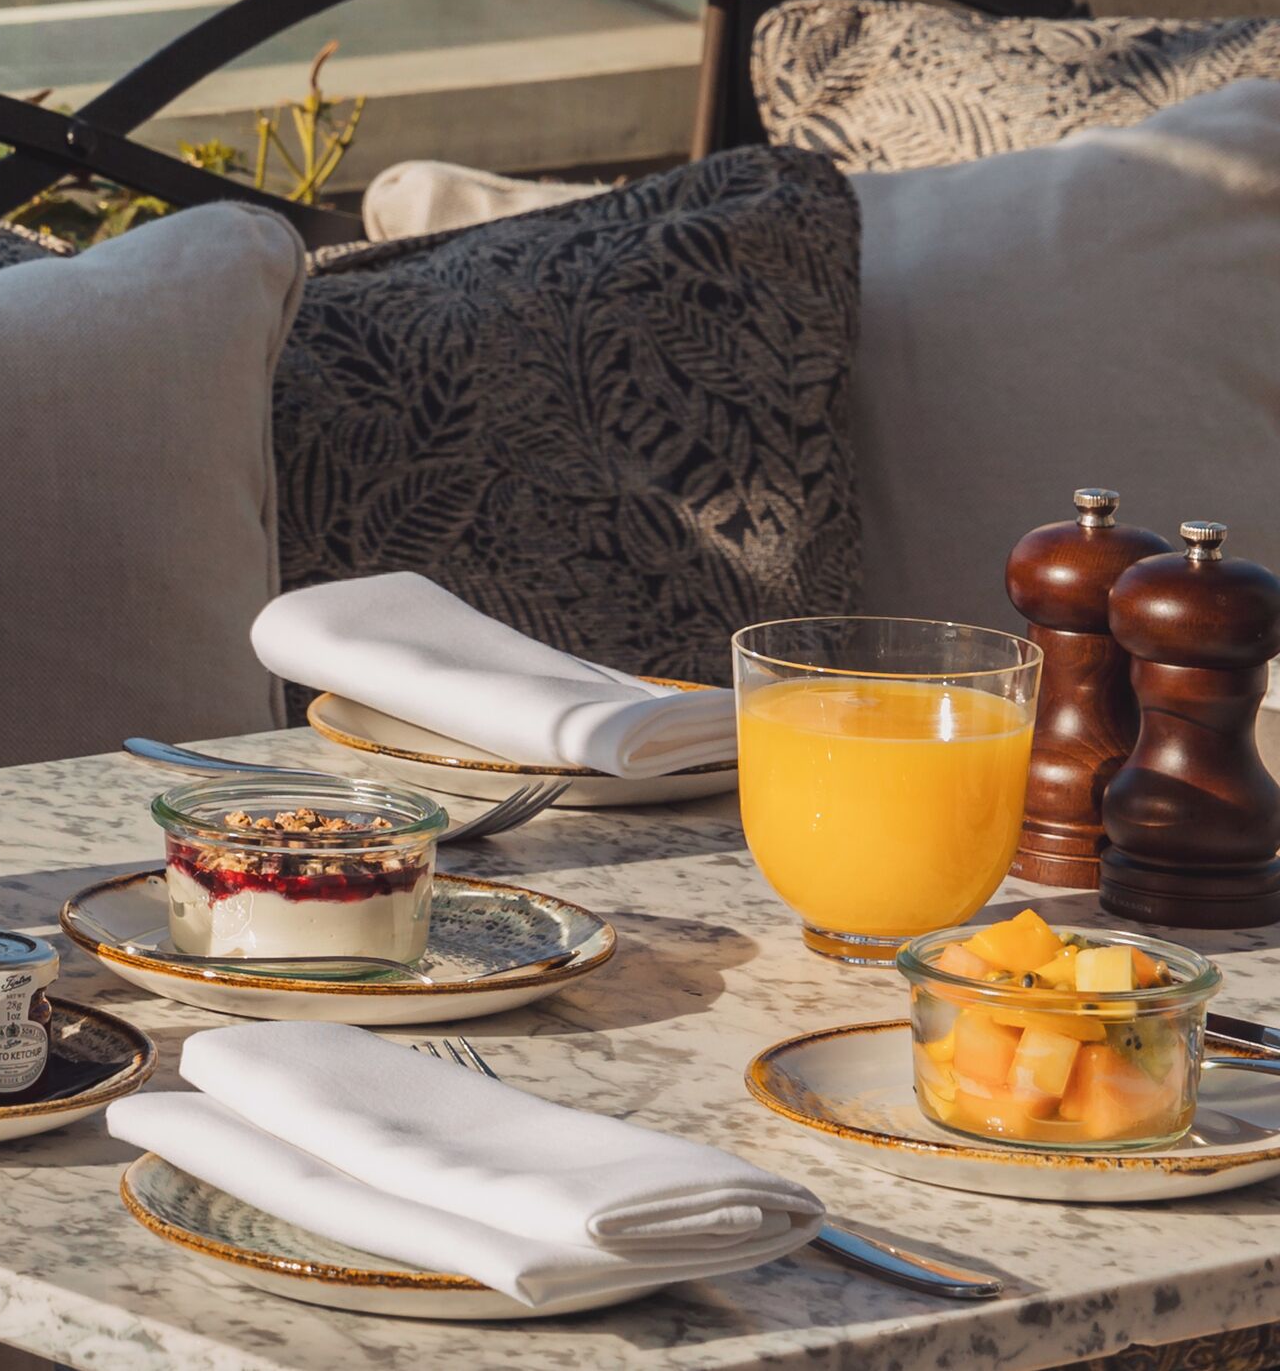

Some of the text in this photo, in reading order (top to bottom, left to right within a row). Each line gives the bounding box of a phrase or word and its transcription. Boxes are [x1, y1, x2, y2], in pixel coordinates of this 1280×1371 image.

[1, 975, 31, 992] Tiptree
[6, 1001, 22, 1011] 28g
[7, 1012, 21, 1021] 1oz
[11, 1047, 42, 1059] KETCHUP
